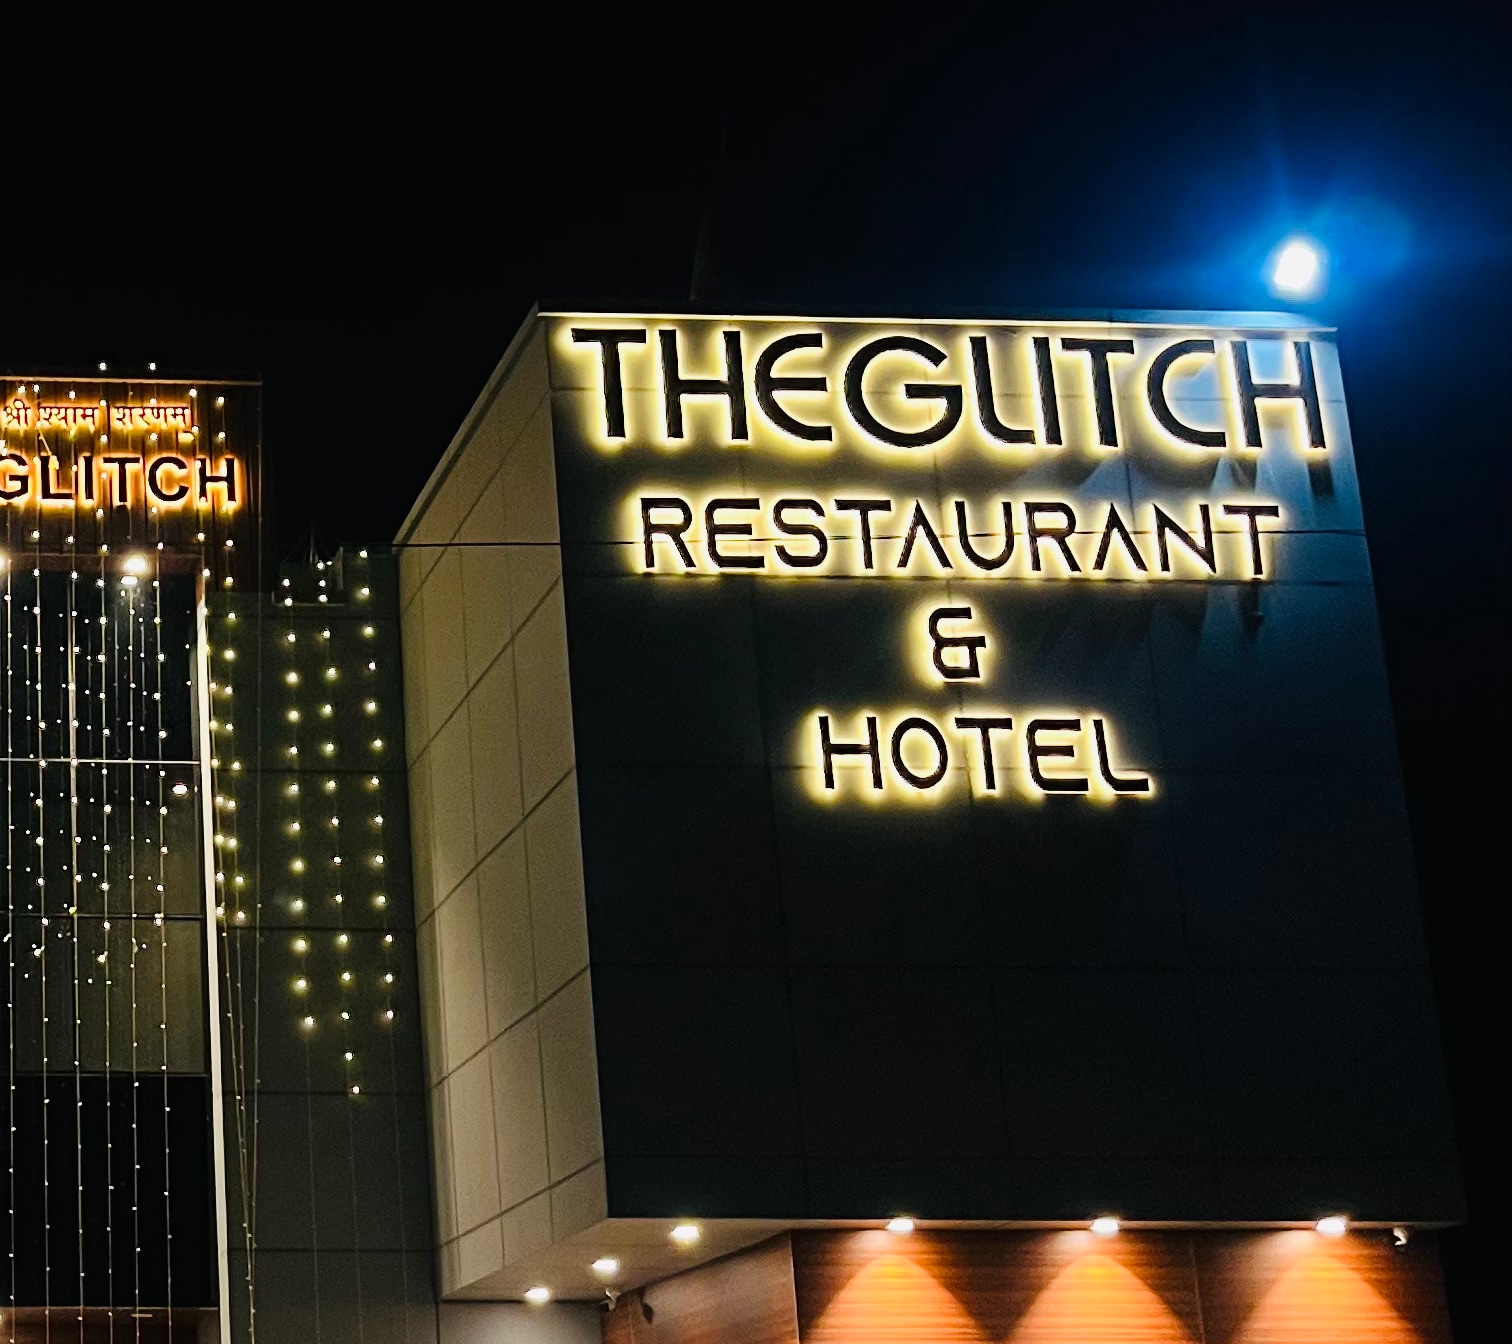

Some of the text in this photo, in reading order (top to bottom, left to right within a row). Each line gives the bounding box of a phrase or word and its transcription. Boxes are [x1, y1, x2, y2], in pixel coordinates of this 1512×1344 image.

[2, 398, 33, 427] श्री
[640, 497, 1280, 576] RESTAURANT
[929, 606, 987, 680] &
[818, 714, 1150, 794] HOTEL
